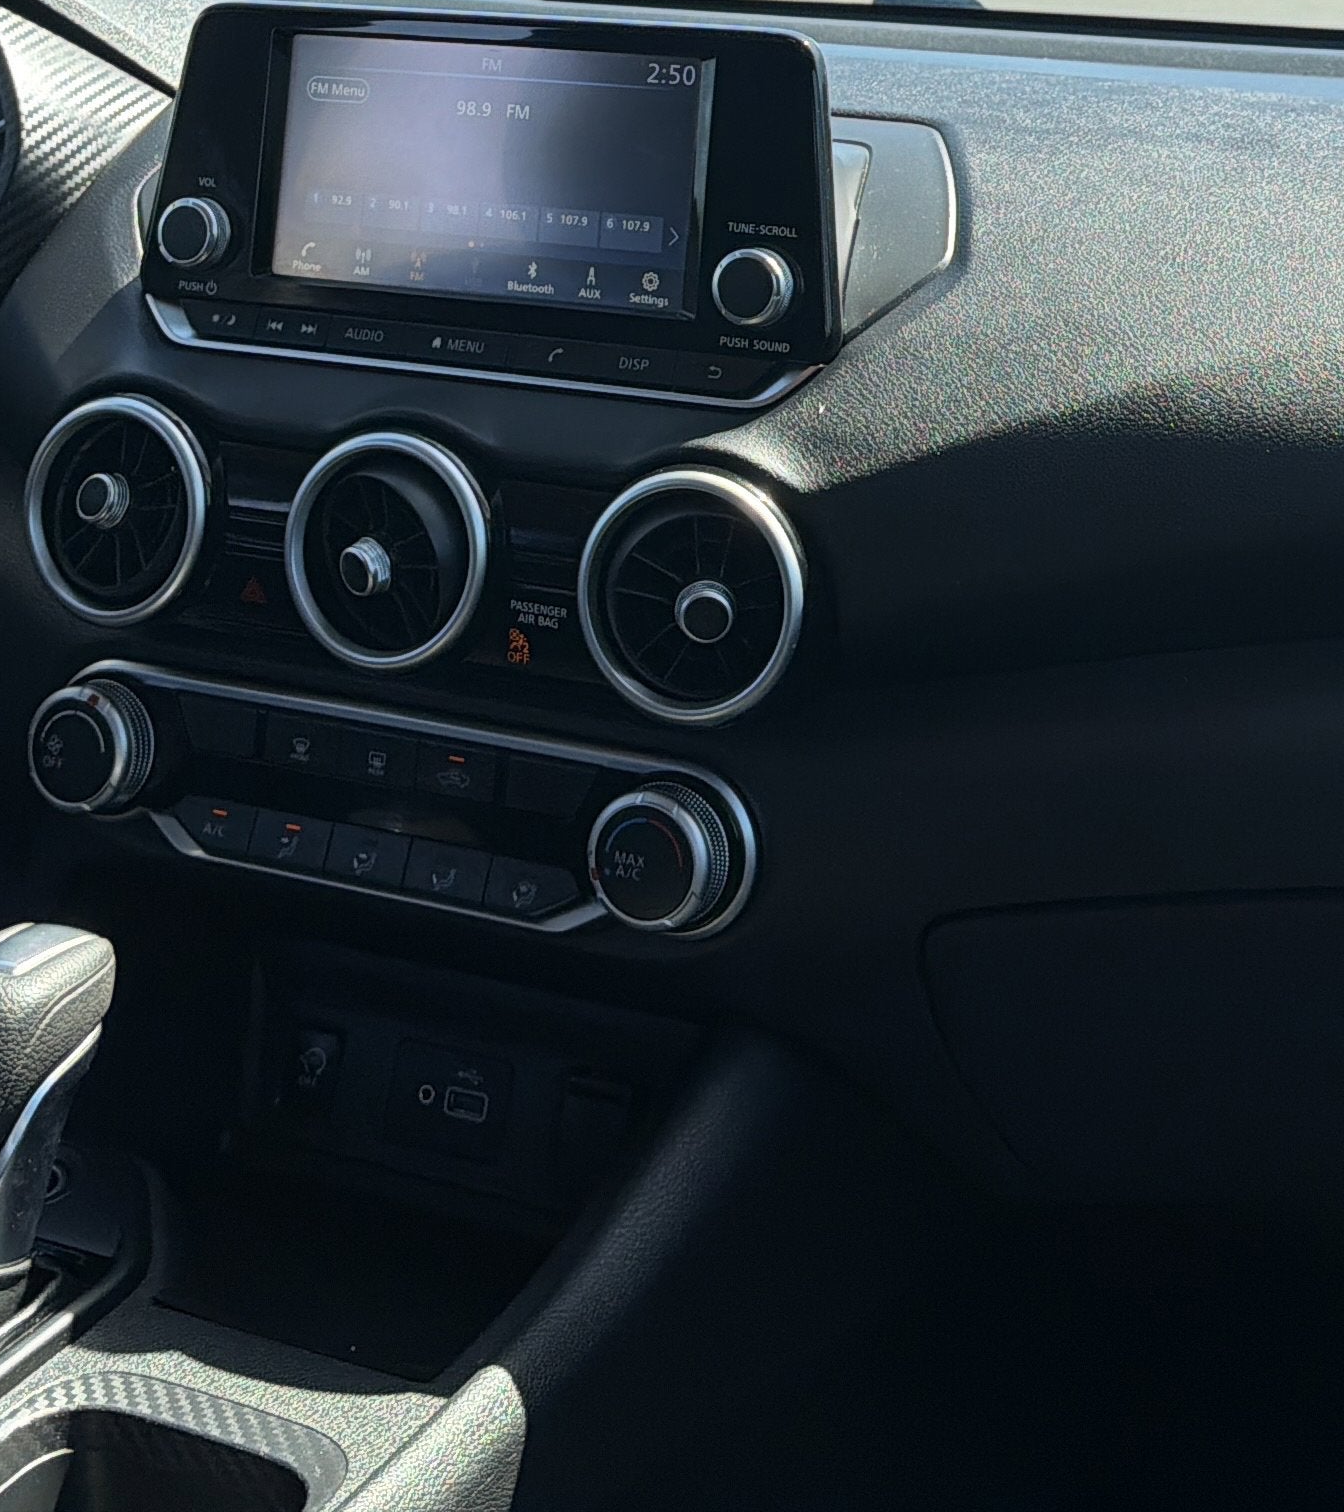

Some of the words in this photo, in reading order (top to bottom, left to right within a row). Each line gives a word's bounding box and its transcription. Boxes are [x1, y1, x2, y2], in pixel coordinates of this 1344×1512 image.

[481, 57, 503, 73] FM
[646, 62, 697, 86] 2:50
[310, 81, 329, 95] FM
[331, 83, 366, 97] Menu
[455, 100, 492, 117] 98.9
[505, 103, 531, 120] FM
[198, 176, 216, 188] VOL
[500, 209, 527, 221] 106.1
[546, 213, 553, 224] 5
[560, 214, 588, 227] 107.9
[606, 218, 614, 229] 6
[622, 219, 651, 232] 107.9
[292, 259, 322, 273] Phone
[352, 265, 371, 276] AM
[178, 279, 204, 292] PUSH
[506, 280, 555, 295] Bluetooth
[578, 287, 601, 300] AUX
[629, 292, 669, 308] Settings
[344, 327, 384, 343] AUDIO
[446, 338, 485, 354] MENU
[719, 335, 749, 349] PUSH
[753, 339, 791, 353] SOUND
[618, 356, 650, 372] DISP
[510, 599, 568, 619] PASSENGER
[517, 612, 536, 625] AIR
[537, 615, 559, 629] BAG
[507, 651, 531, 665] OFF
[201, 822, 225, 838] A/C
[614, 849, 645, 869] MAX
[616, 865, 642, 882] A/C
